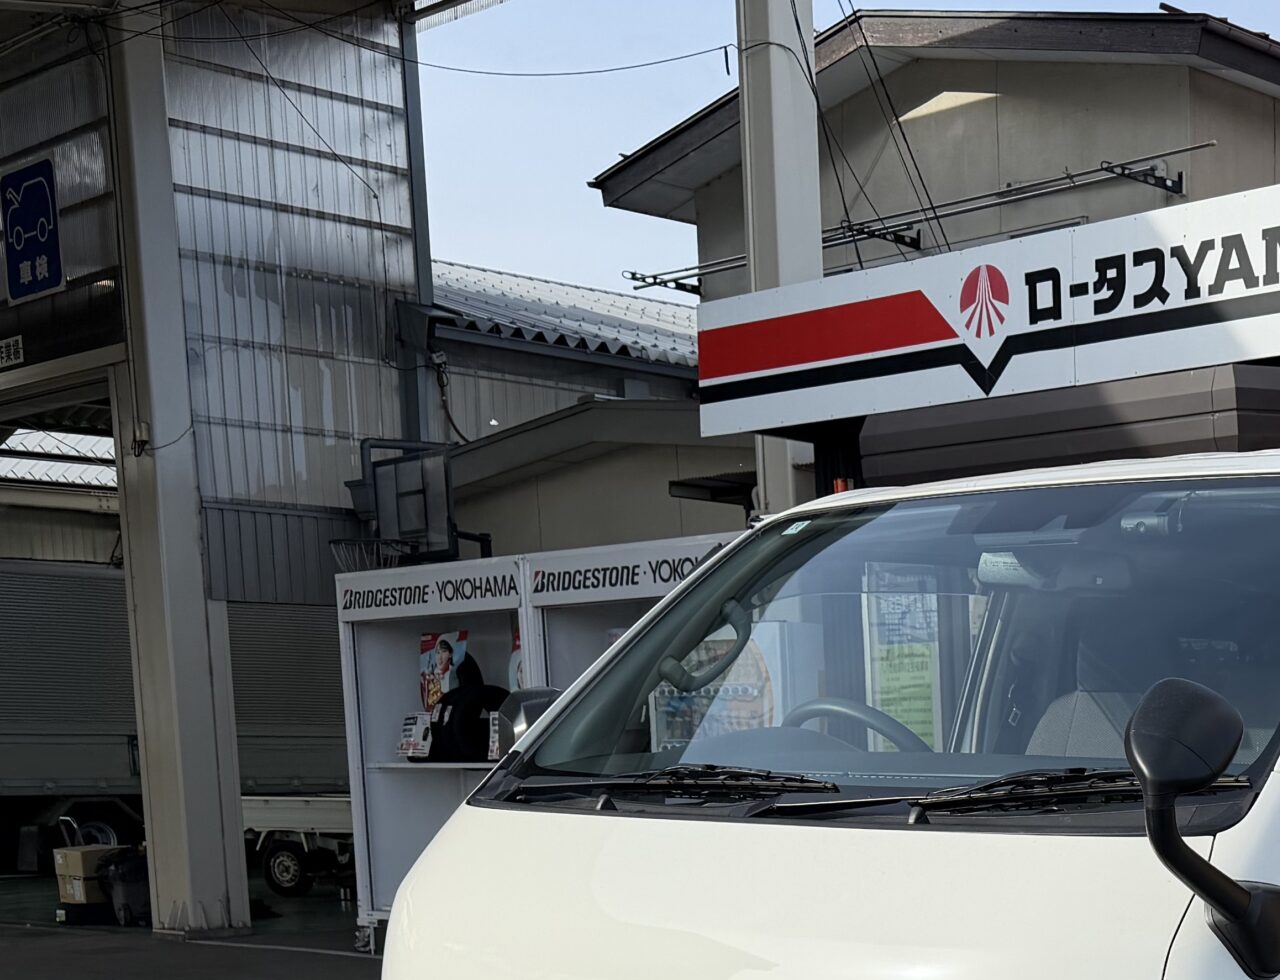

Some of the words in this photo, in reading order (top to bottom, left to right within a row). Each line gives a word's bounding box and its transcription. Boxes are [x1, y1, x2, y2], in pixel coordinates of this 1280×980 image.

[19, 253, 49, 285] 車検
[342, 584, 430, 610] BRIDGESTONE
[435, 573, 519, 603] YOKOHAMA
[532, 564, 641, 594] BRIDGESTONE
[648, 556, 699, 584] YOKO
